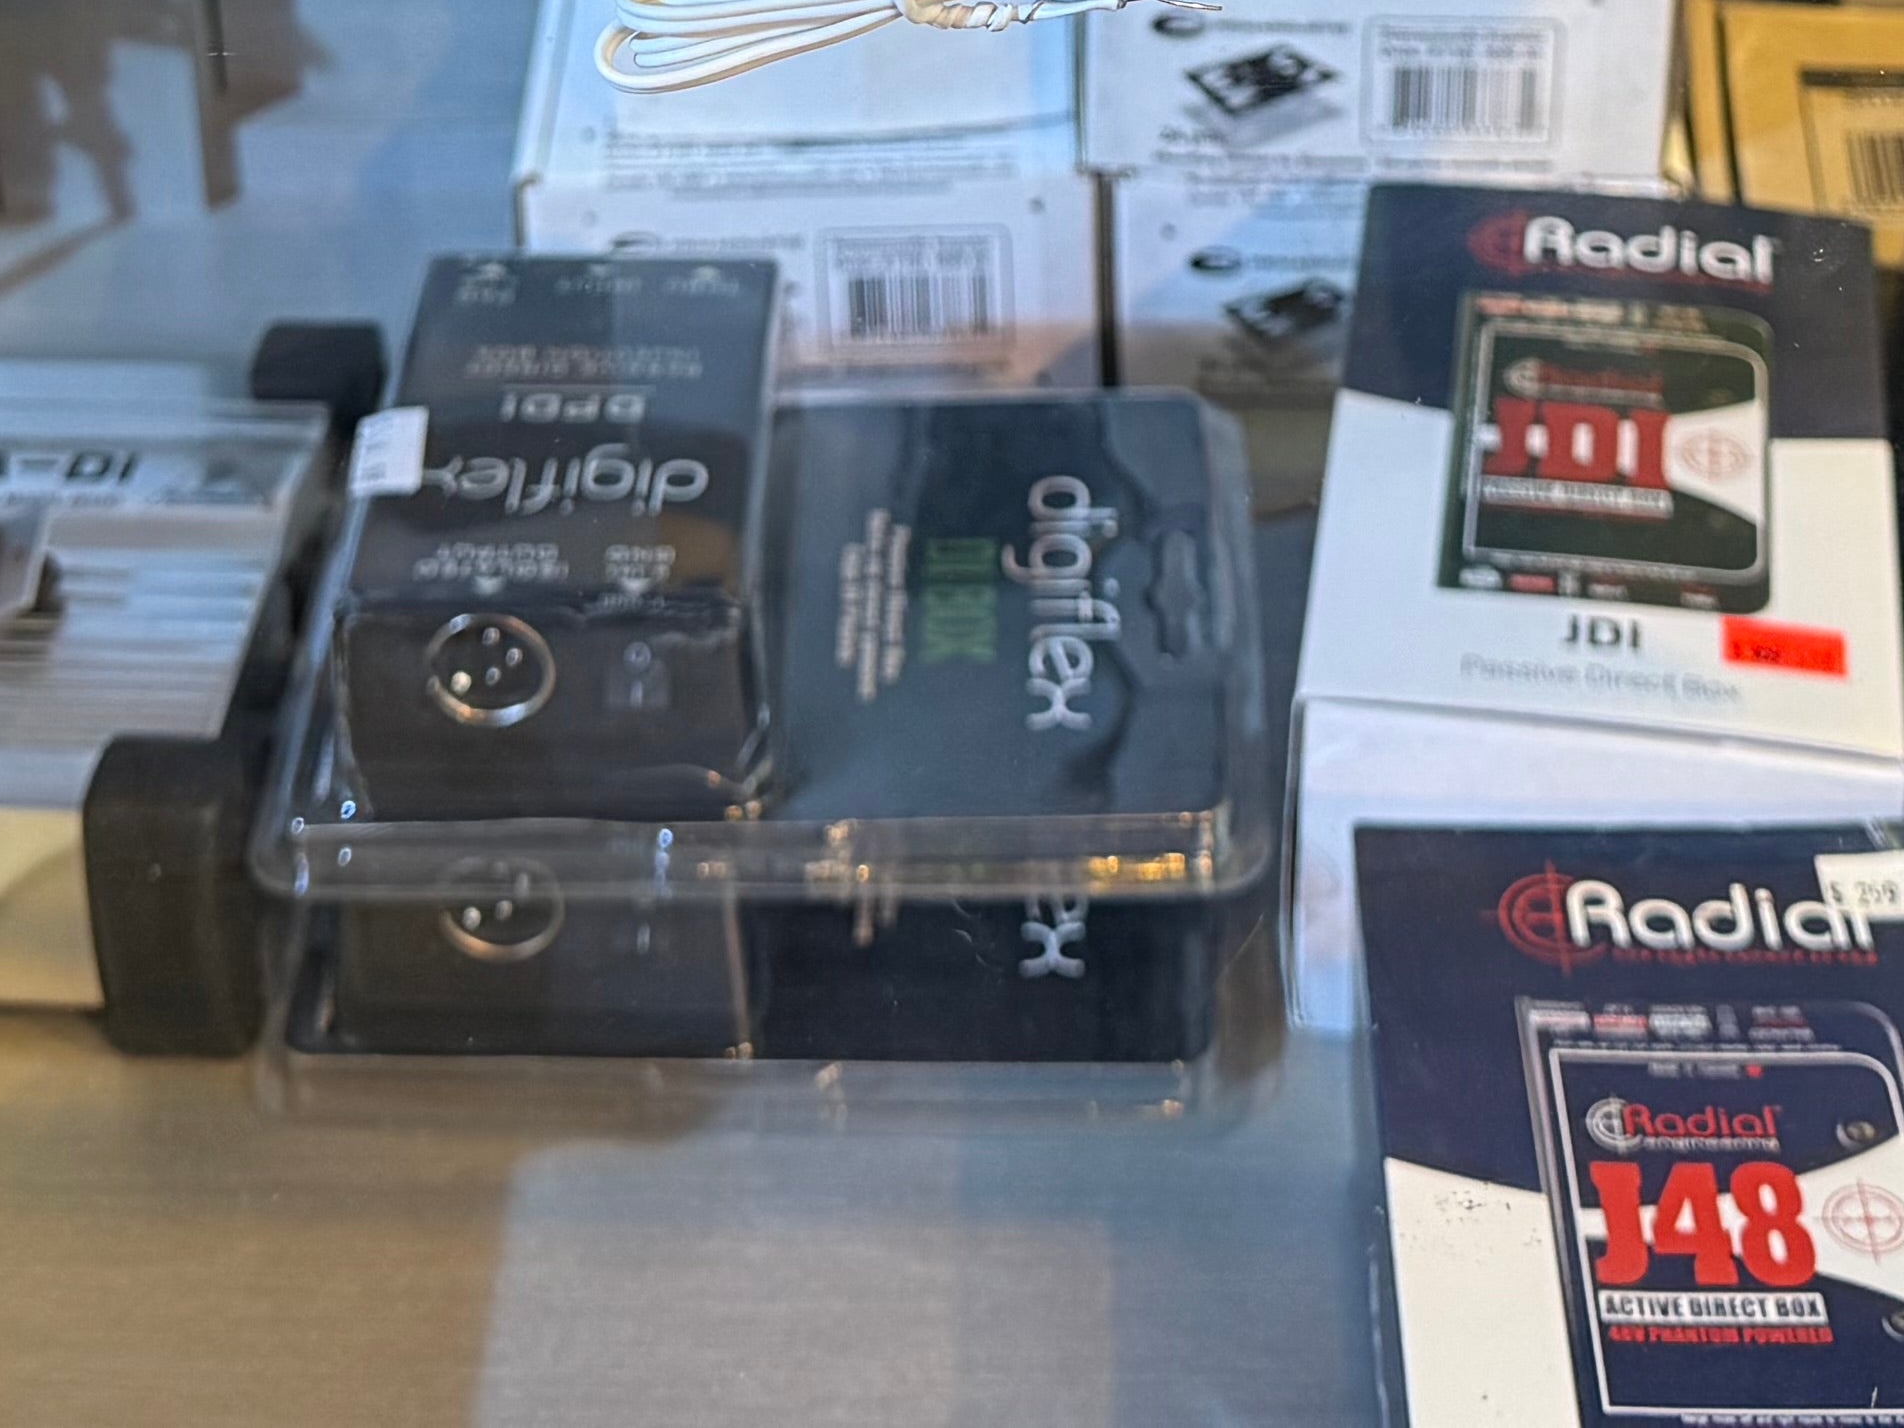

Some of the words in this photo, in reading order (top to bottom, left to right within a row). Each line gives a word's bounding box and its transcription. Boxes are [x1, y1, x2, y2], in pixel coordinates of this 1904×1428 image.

[1522, 215, 1776, 285] Radial
[1002, 475, 1122, 732] digiflex
[1563, 614, 1642, 651] JDI
[1623, 1103, 1783, 1138] Radial
[1589, 1161, 1817, 1287] J48
[1604, 1293, 1684, 1319] ACTIVE
[1687, 1293, 1769, 1319] DIRECT
[1774, 1294, 1821, 1319] BOX
